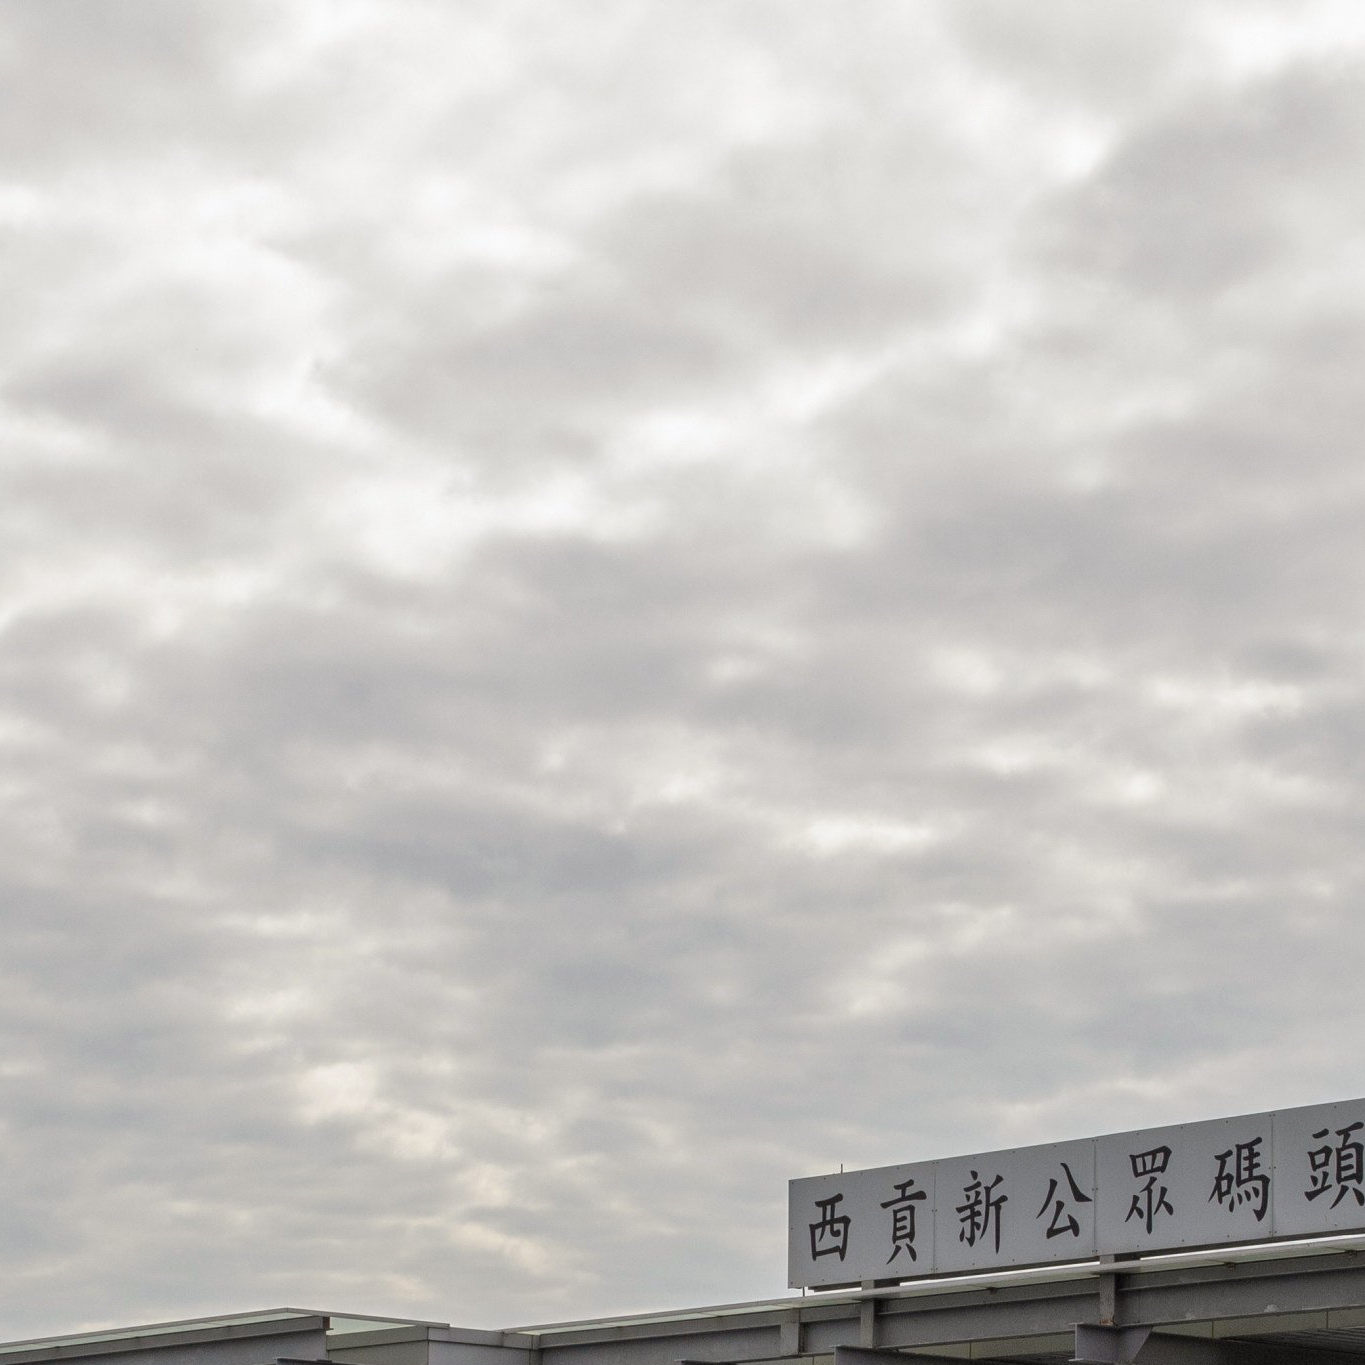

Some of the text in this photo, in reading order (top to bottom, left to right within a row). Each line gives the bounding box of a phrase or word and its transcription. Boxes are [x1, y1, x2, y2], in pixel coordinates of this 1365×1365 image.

[807, 1120, 1365, 1266] 西貢新公眾碼頭
